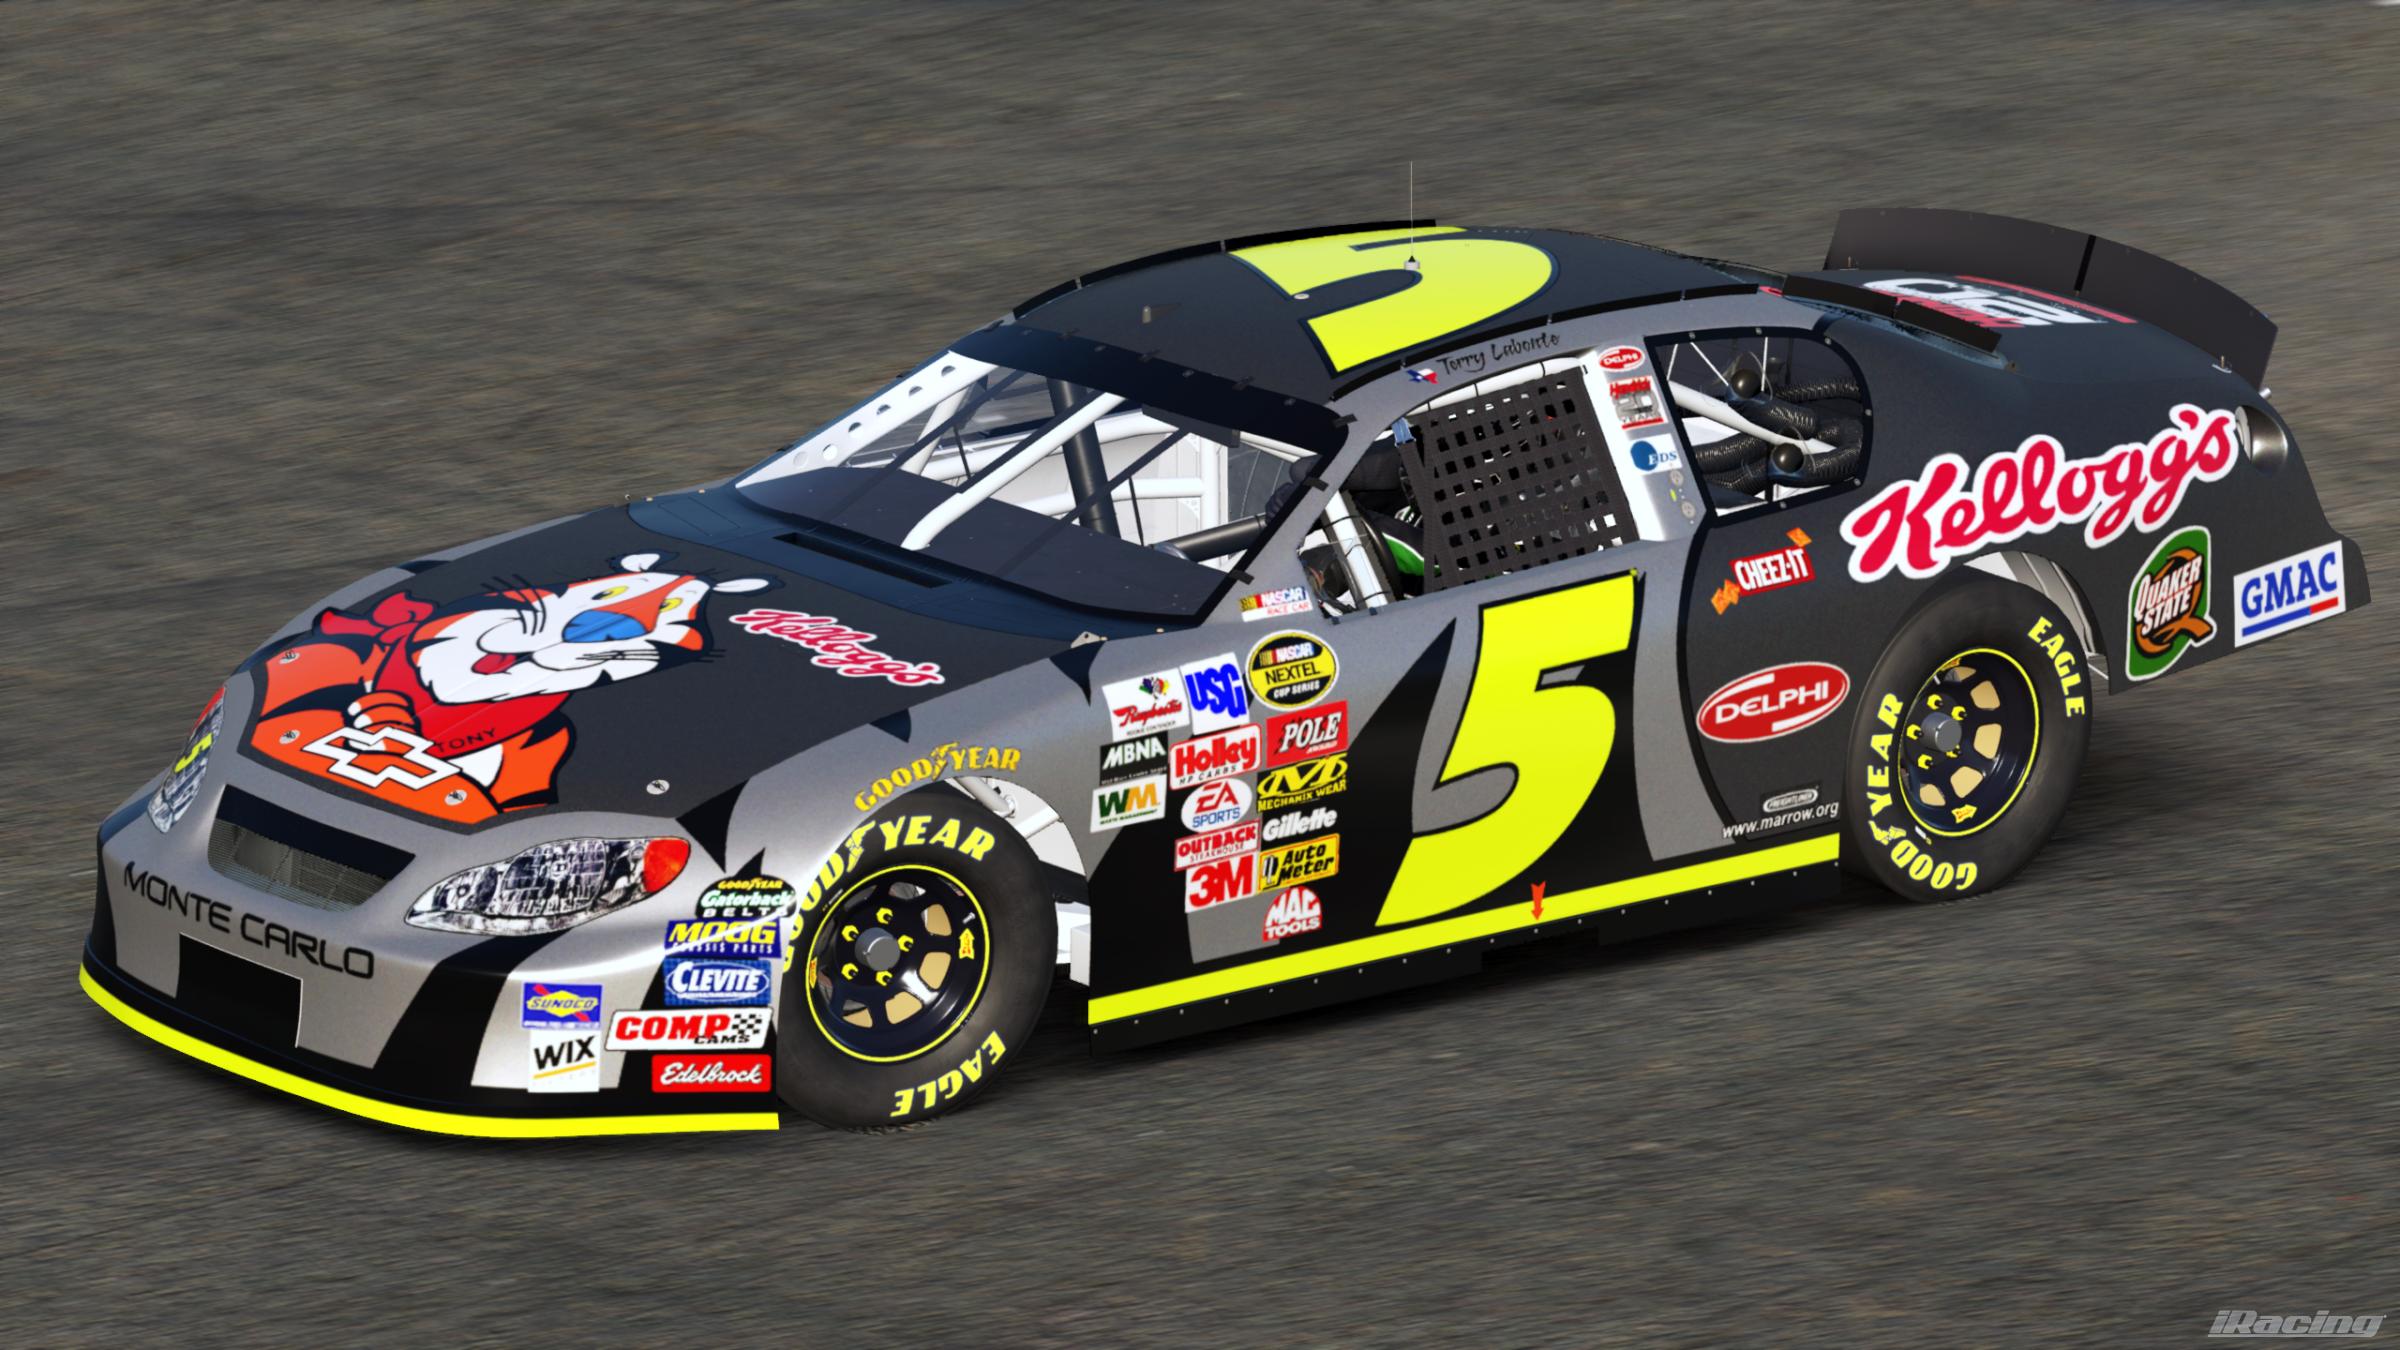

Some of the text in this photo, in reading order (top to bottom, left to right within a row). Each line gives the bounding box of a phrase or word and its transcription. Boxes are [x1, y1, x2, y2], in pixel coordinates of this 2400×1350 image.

[1229, 226, 1553, 372] 5
[1436, 332, 1560, 376] Terry Labonte
[1603, 352, 1640, 366] DELPHI
[1648, 450, 1678, 466] EDS
[1849, 407, 2233, 577] Kellogg's
[1260, 586, 1307, 607] NASCAR
[2134, 555, 2203, 622] QUAKER
[2241, 551, 2338, 619] GMAC
[1267, 603, 1310, 615] RACE CAR
[2142, 585, 2193, 636] STATE
[732, 609, 942, 685] Kellogg's
[1276, 641, 1315, 663] NASCAR
[1264, 661, 1321, 685] NEXTEL
[2027, 616, 2086, 718] EAGLE
[1184, 663, 1247, 718] USG
[1273, 679, 1320, 699] CUP SERIES
[1714, 680, 1830, 724] DELPHI
[435, 727, 496, 753] TONY
[1279, 711, 1343, 753] POLE
[174, 732, 213, 773] 5
[1102, 736, 1167, 770] MBNA
[1175, 736, 1257, 778] Holley
[1375, 573, 1636, 928] 5
[1097, 782, 1158, 818] WM
[1195, 782, 1239, 814] EA
[1257, 777, 1347, 812] MECHANIX WEAR
[1192, 807, 1240, 828] SPORTS
[1262, 806, 1338, 842] Gillette
[1722, 801, 1840, 839] www.marrow.org
[1178, 825, 1256, 858] OUTBACK
[1190, 843, 1245, 863] STEAKHOUSE
[1282, 844, 1327, 866] Auto
[1189, 854, 1254, 908] 3M
[1279, 857, 1335, 881] Meter
[700, 889, 792, 908] Gatorback
[1265, 887, 1321, 927] MAC
[124, 861, 375, 980] MONTE CARLO
[668, 921, 777, 945] MOOG
[1265, 917, 1320, 939] TOOLS
[672, 961, 765, 993] CLEVITE
[530, 998, 595, 1009] SUNOCO
[615, 1014, 731, 1041] COMP
[693, 1034, 750, 1045] CAMS
[533, 1034, 596, 1071] WIX
[660, 1061, 763, 1086] Edelbrock
[890, 1031, 1007, 1117] EAGLE
